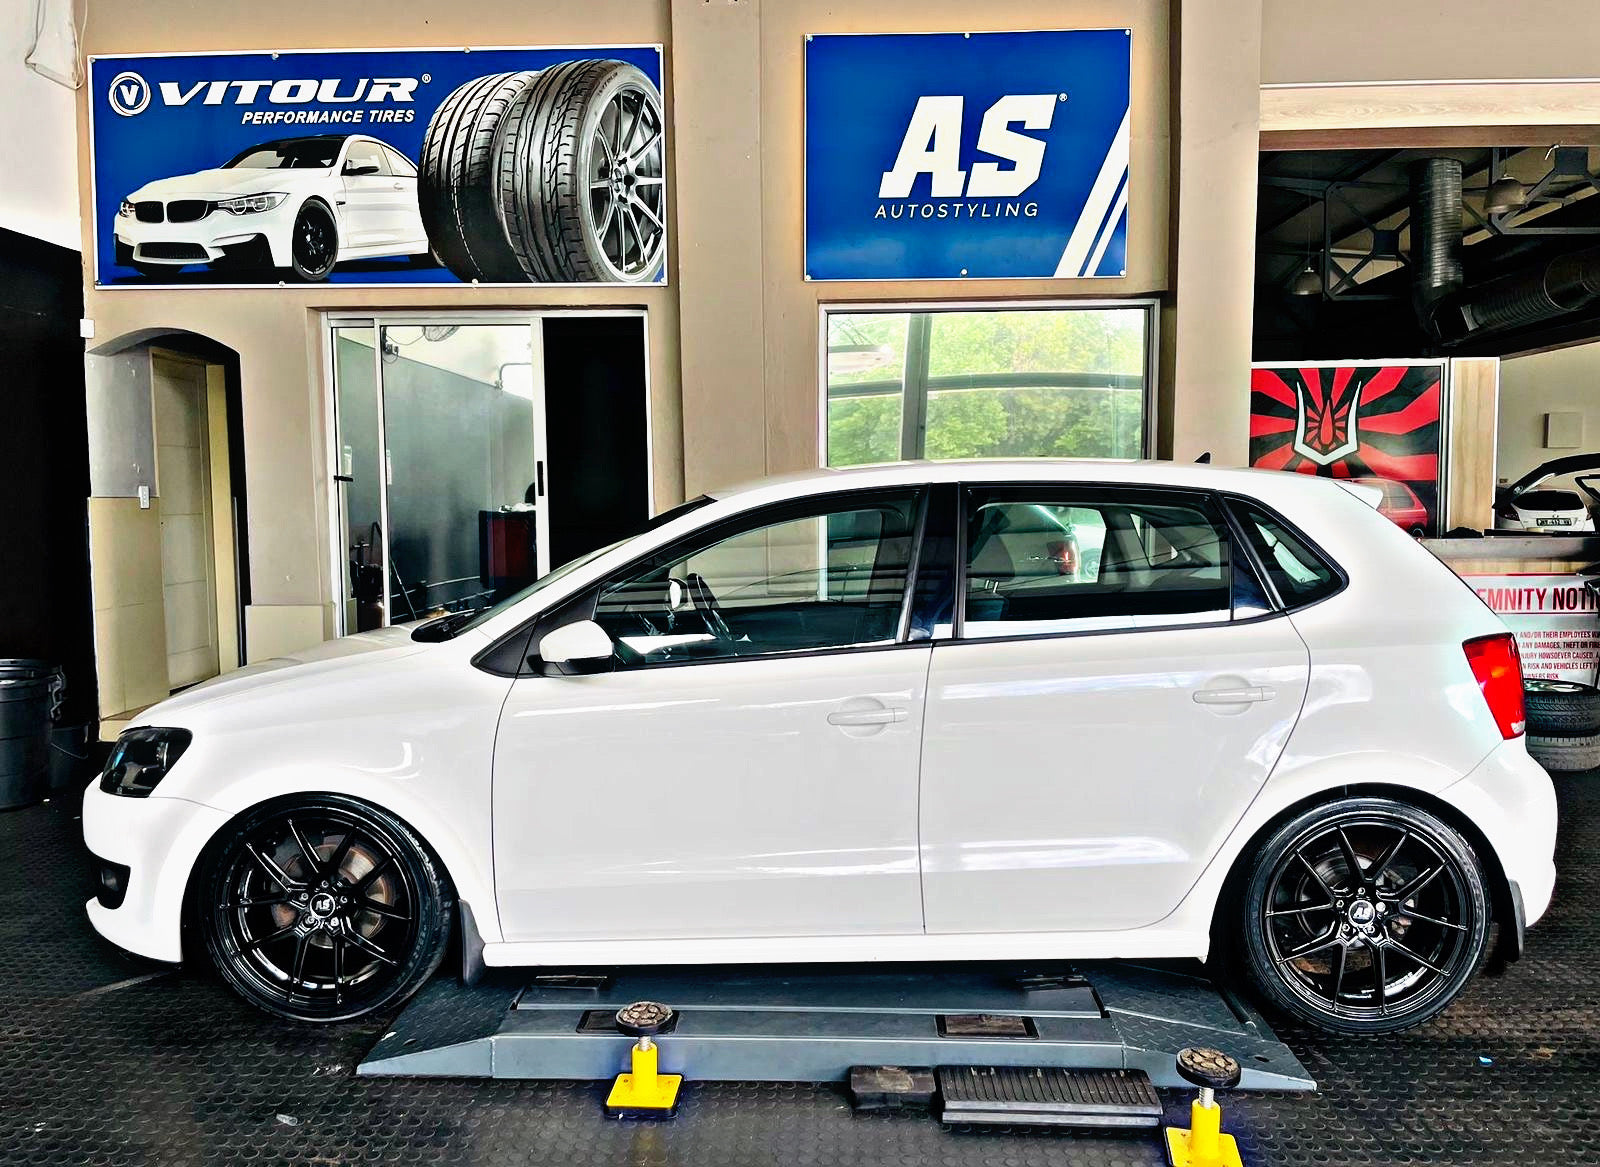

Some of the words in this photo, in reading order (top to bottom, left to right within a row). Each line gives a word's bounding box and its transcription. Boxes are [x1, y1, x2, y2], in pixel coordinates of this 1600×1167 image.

[241, 110, 363, 125] PERFORMANCE
[369, 109, 415, 123] TIRES
[874, 202, 1039, 219] AUTOSTYLING
[1519, 631, 1542, 639] AND/OR
[1543, 631, 1558, 639] THEIR
[1559, 631, 1591, 639] EMPLOYEES
[1521, 641, 1533, 649] ANY
[1563, 641, 1580, 649] THEFT
[1580, 641, 1589, 649] OR
[1538, 652, 1572, 660] HOWSOEVER
[1540, 662, 1552, 670] AND
[1553, 662, 1579, 670] VEHICLES
[1579, 662, 1593, 670] LEFT
